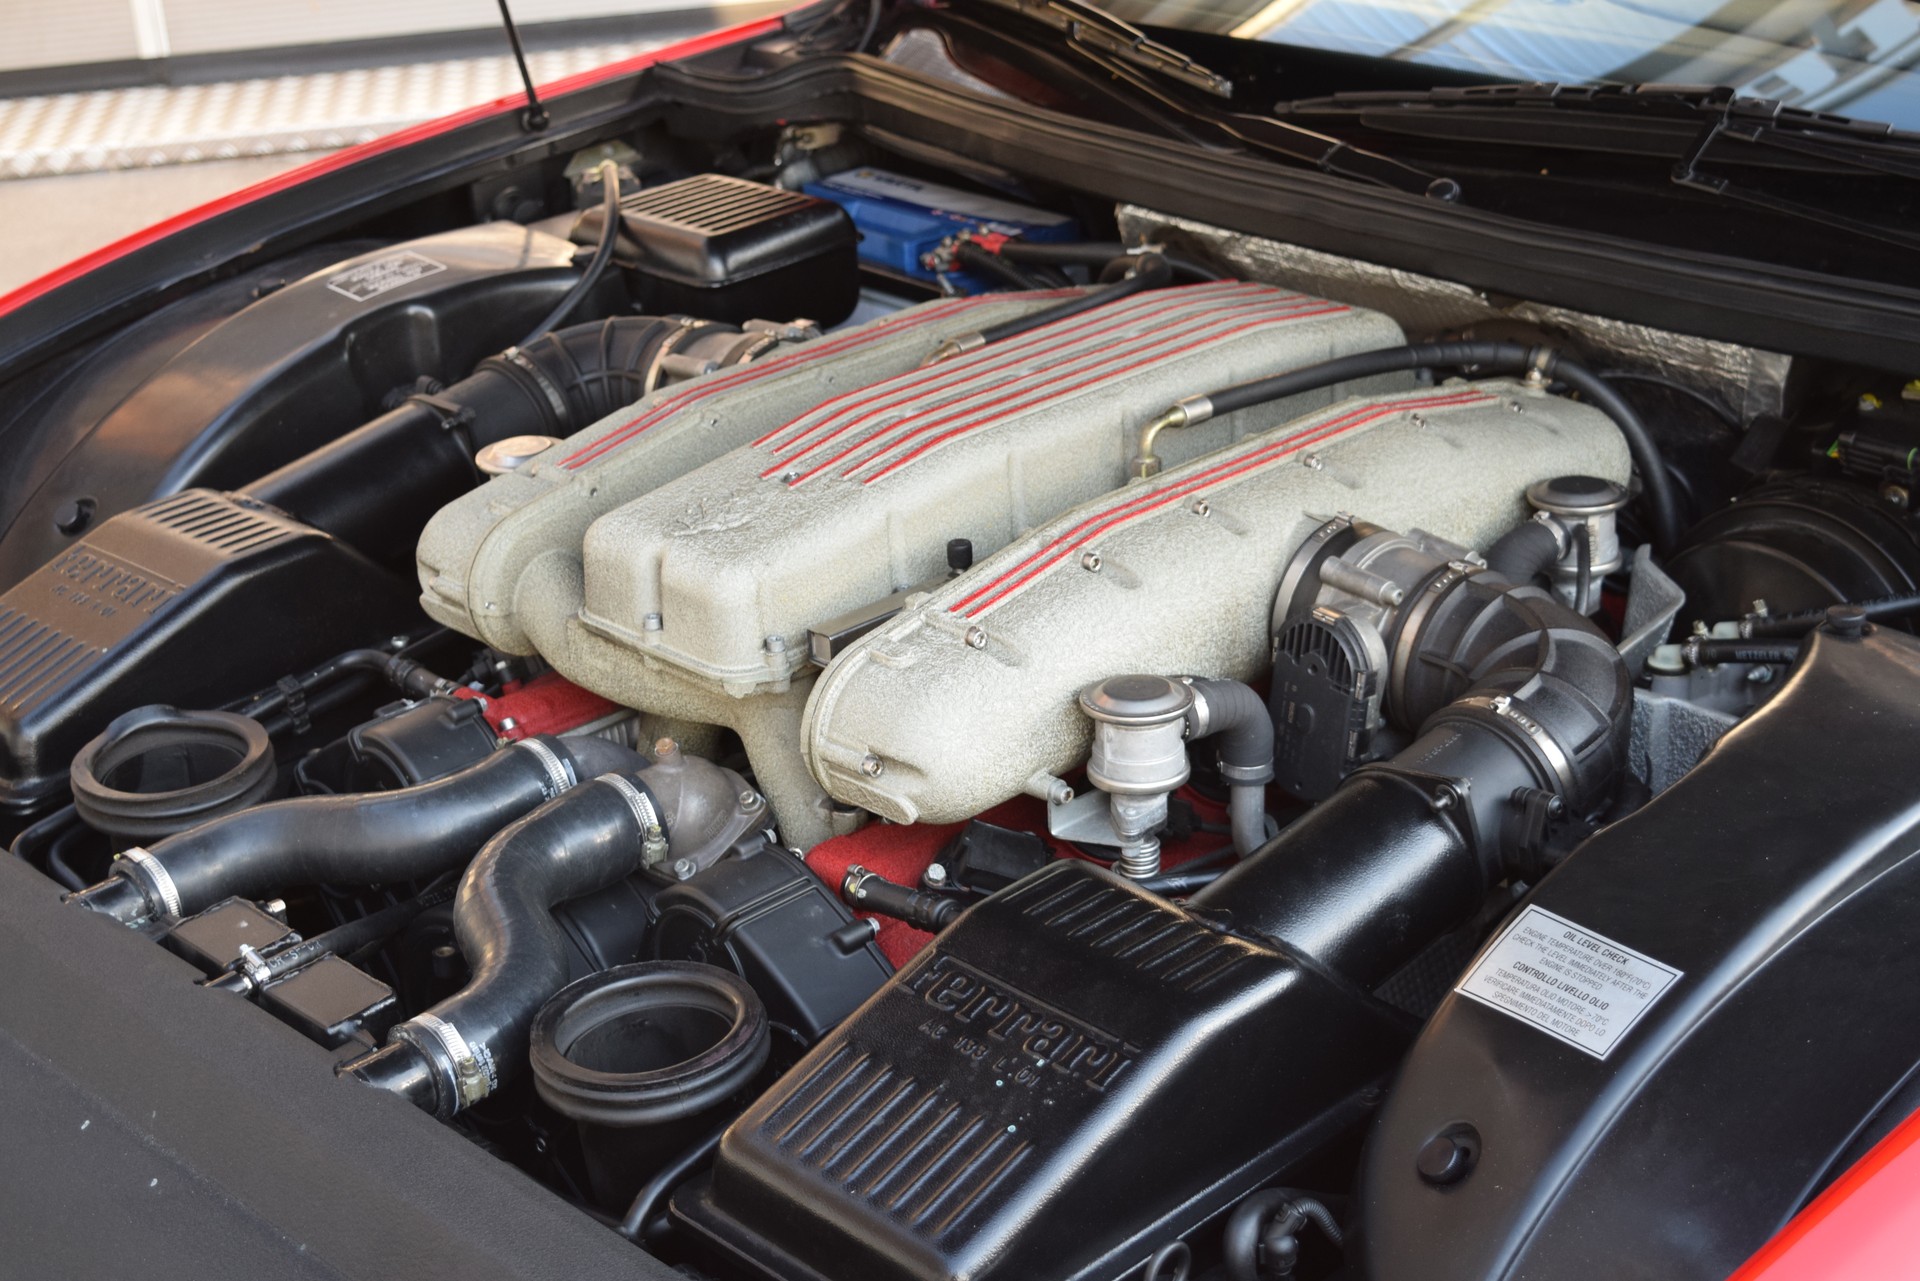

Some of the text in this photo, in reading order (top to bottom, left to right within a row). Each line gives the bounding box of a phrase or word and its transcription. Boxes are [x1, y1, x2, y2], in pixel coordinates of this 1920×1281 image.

[52, 544, 184, 615] Ferrari
[1512, 933, 1649, 1000] CHECK THE LEVEL IMMEDIATELY AFTER THE
[1522, 926, 1548, 942] ENGINE
[1547, 937, 1595, 963] TEMPERATURE
[1592, 958, 1613, 972] OVER
[1562, 930, 1630, 966] OIL LEVEL CHECK
[1495, 968, 1541, 994] TEMPERATURA
[1539, 988, 1558, 1001] OLIO
[1555, 996, 1587, 1015] MOTORE
[1512, 961, 1610, 1011] CONTROLLO LIVELLO OLIO
[1538, 956, 1603, 991] ENGINE IS STOPPED
[896, 950, 1140, 1092] Ferrari
[918, 1018, 949, 1040] AC
[1483, 975, 1607, 1037] VERIFICARE IMMEDIATAMENTE DOPO LO
[1492, 990, 1581, 1036] SPEGNIMENTO DEL MOTORE
